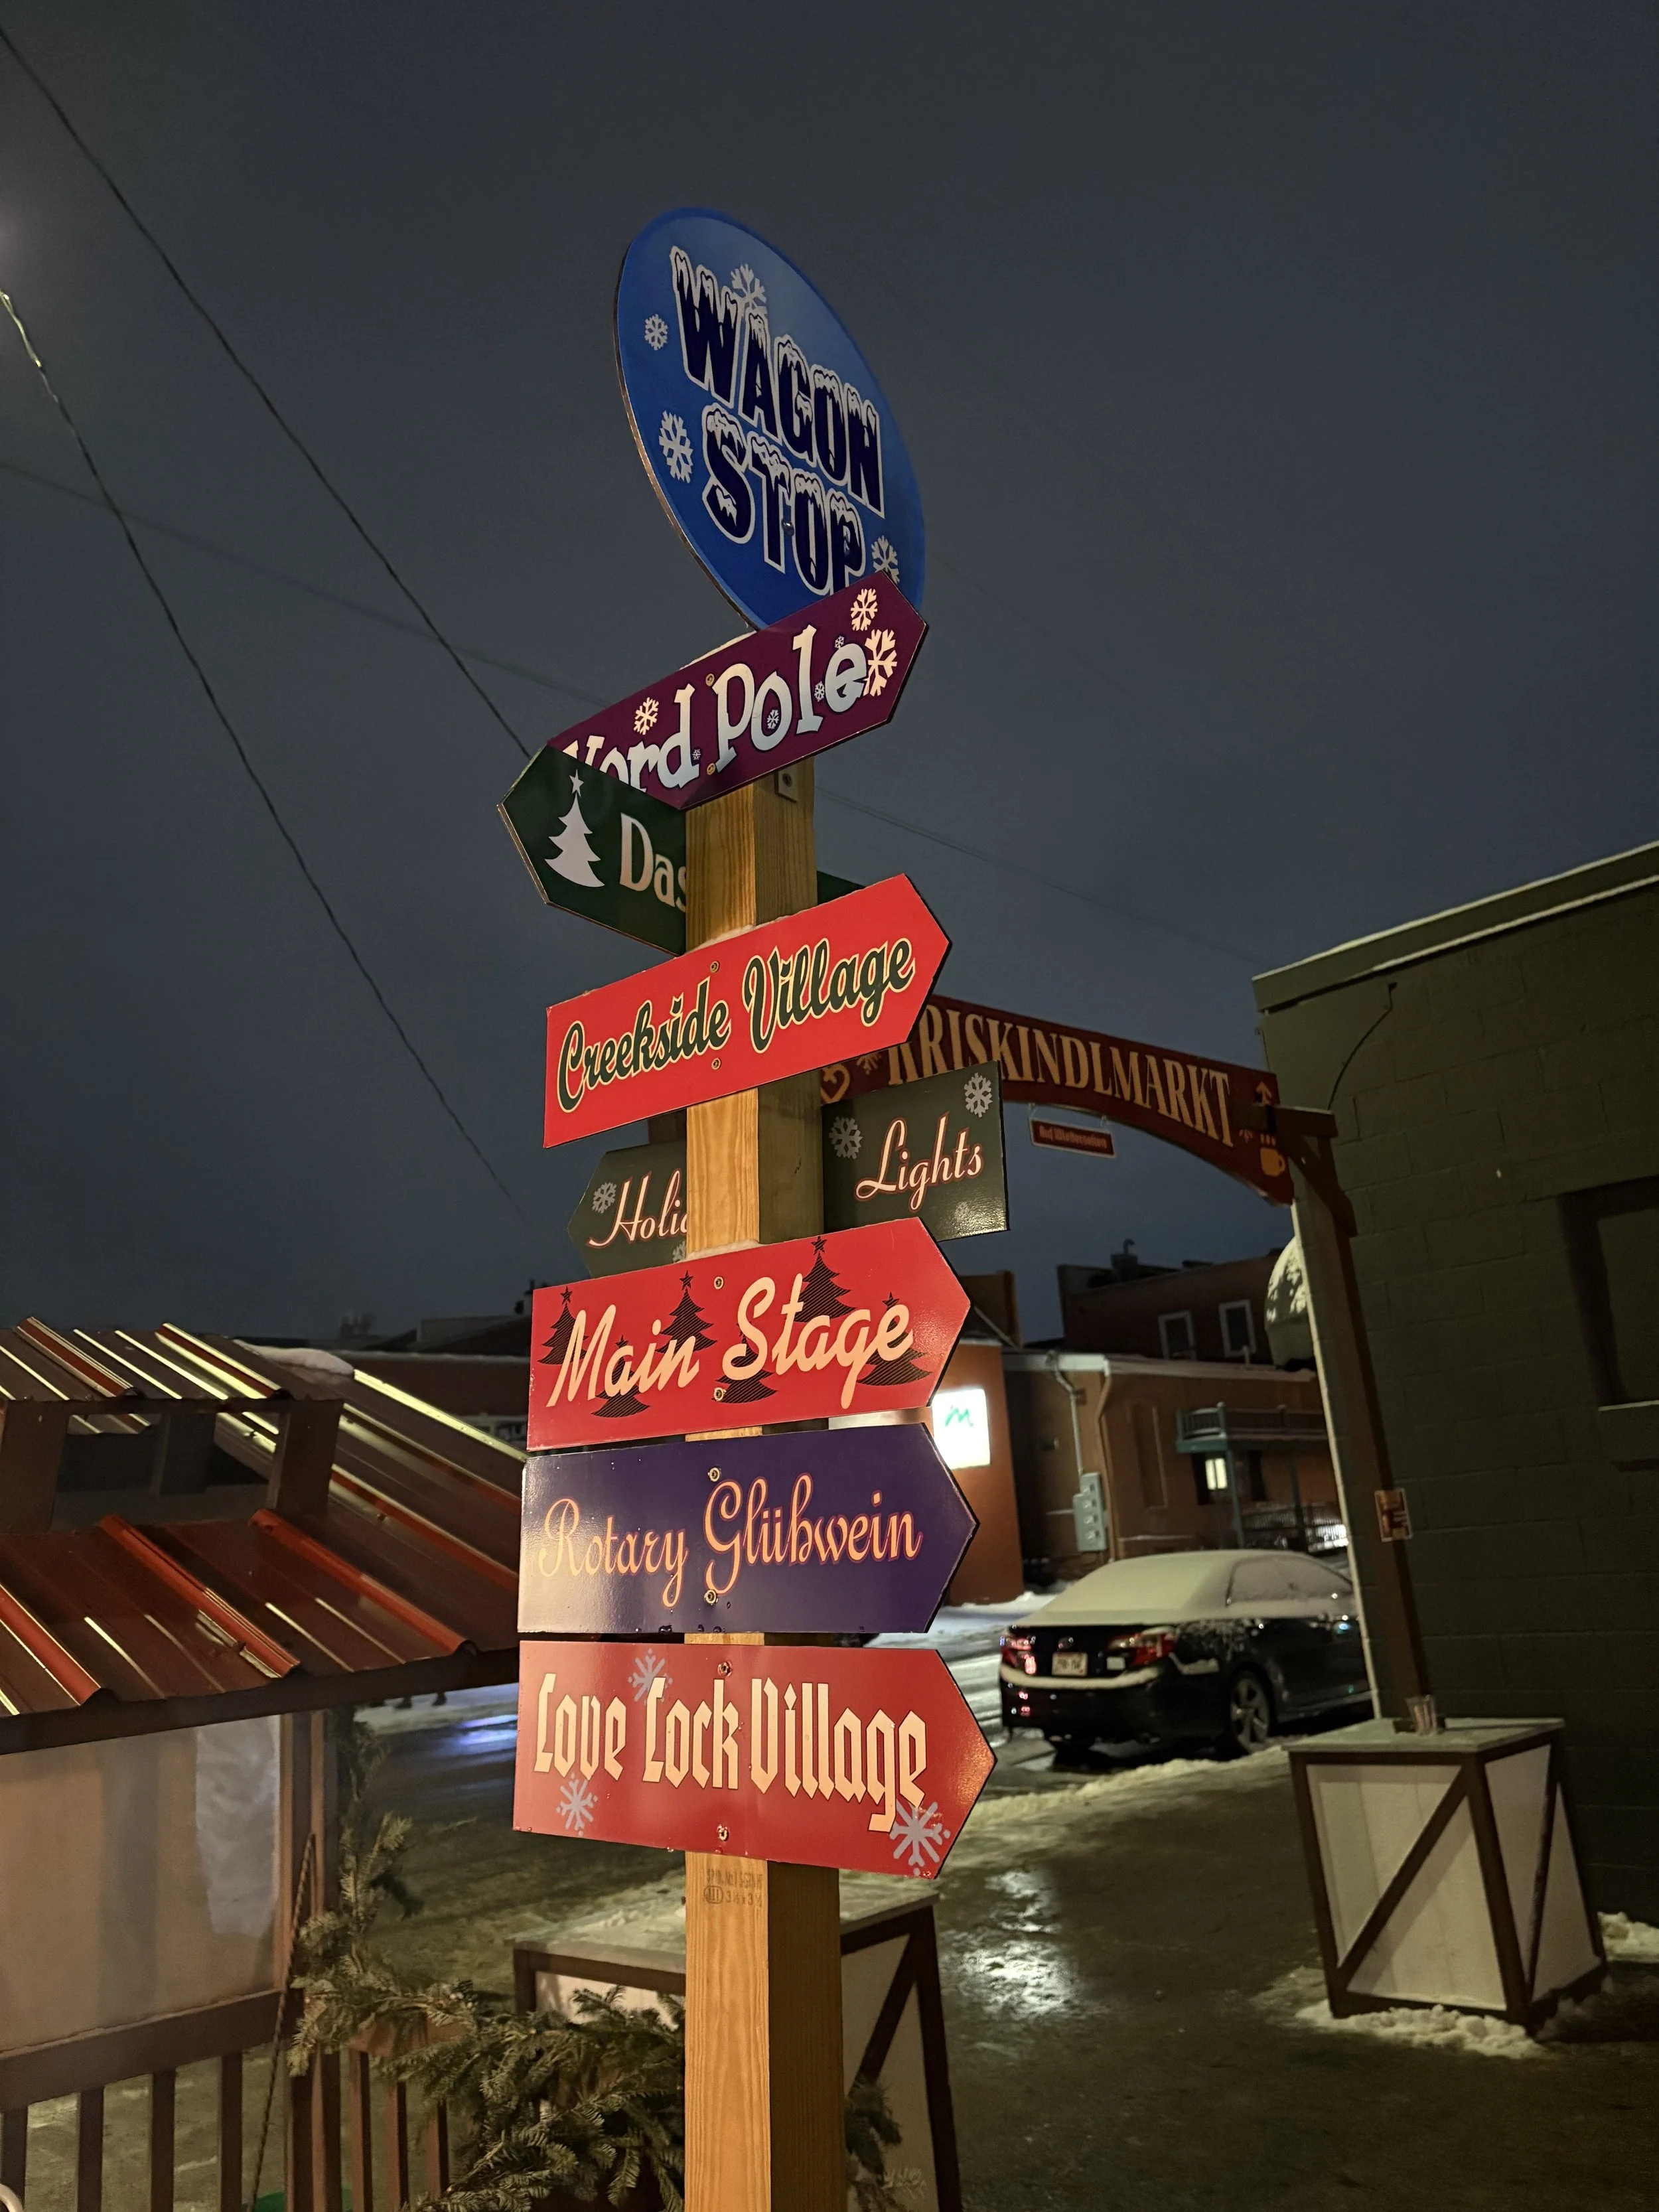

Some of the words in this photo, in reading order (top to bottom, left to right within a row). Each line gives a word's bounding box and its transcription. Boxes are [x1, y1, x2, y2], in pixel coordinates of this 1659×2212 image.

[670, 246, 885, 518] WAGON
[701, 404, 867, 595] STOP
[711, 624, 869, 775] Pole
[557, 976, 732, 1113] Creekside
[743, 937, 917, 1054] Village
[855, 1111, 985, 1213] Lights
[547, 1304, 699, 1408] Main
[722, 1272, 913, 1410] Stage
[538, 1497, 689, 1609] Rotary
[534, 1672, 627, 1781] Love
[642, 1676, 742, 1789] Lock
[750, 1678, 929, 1833] Village
